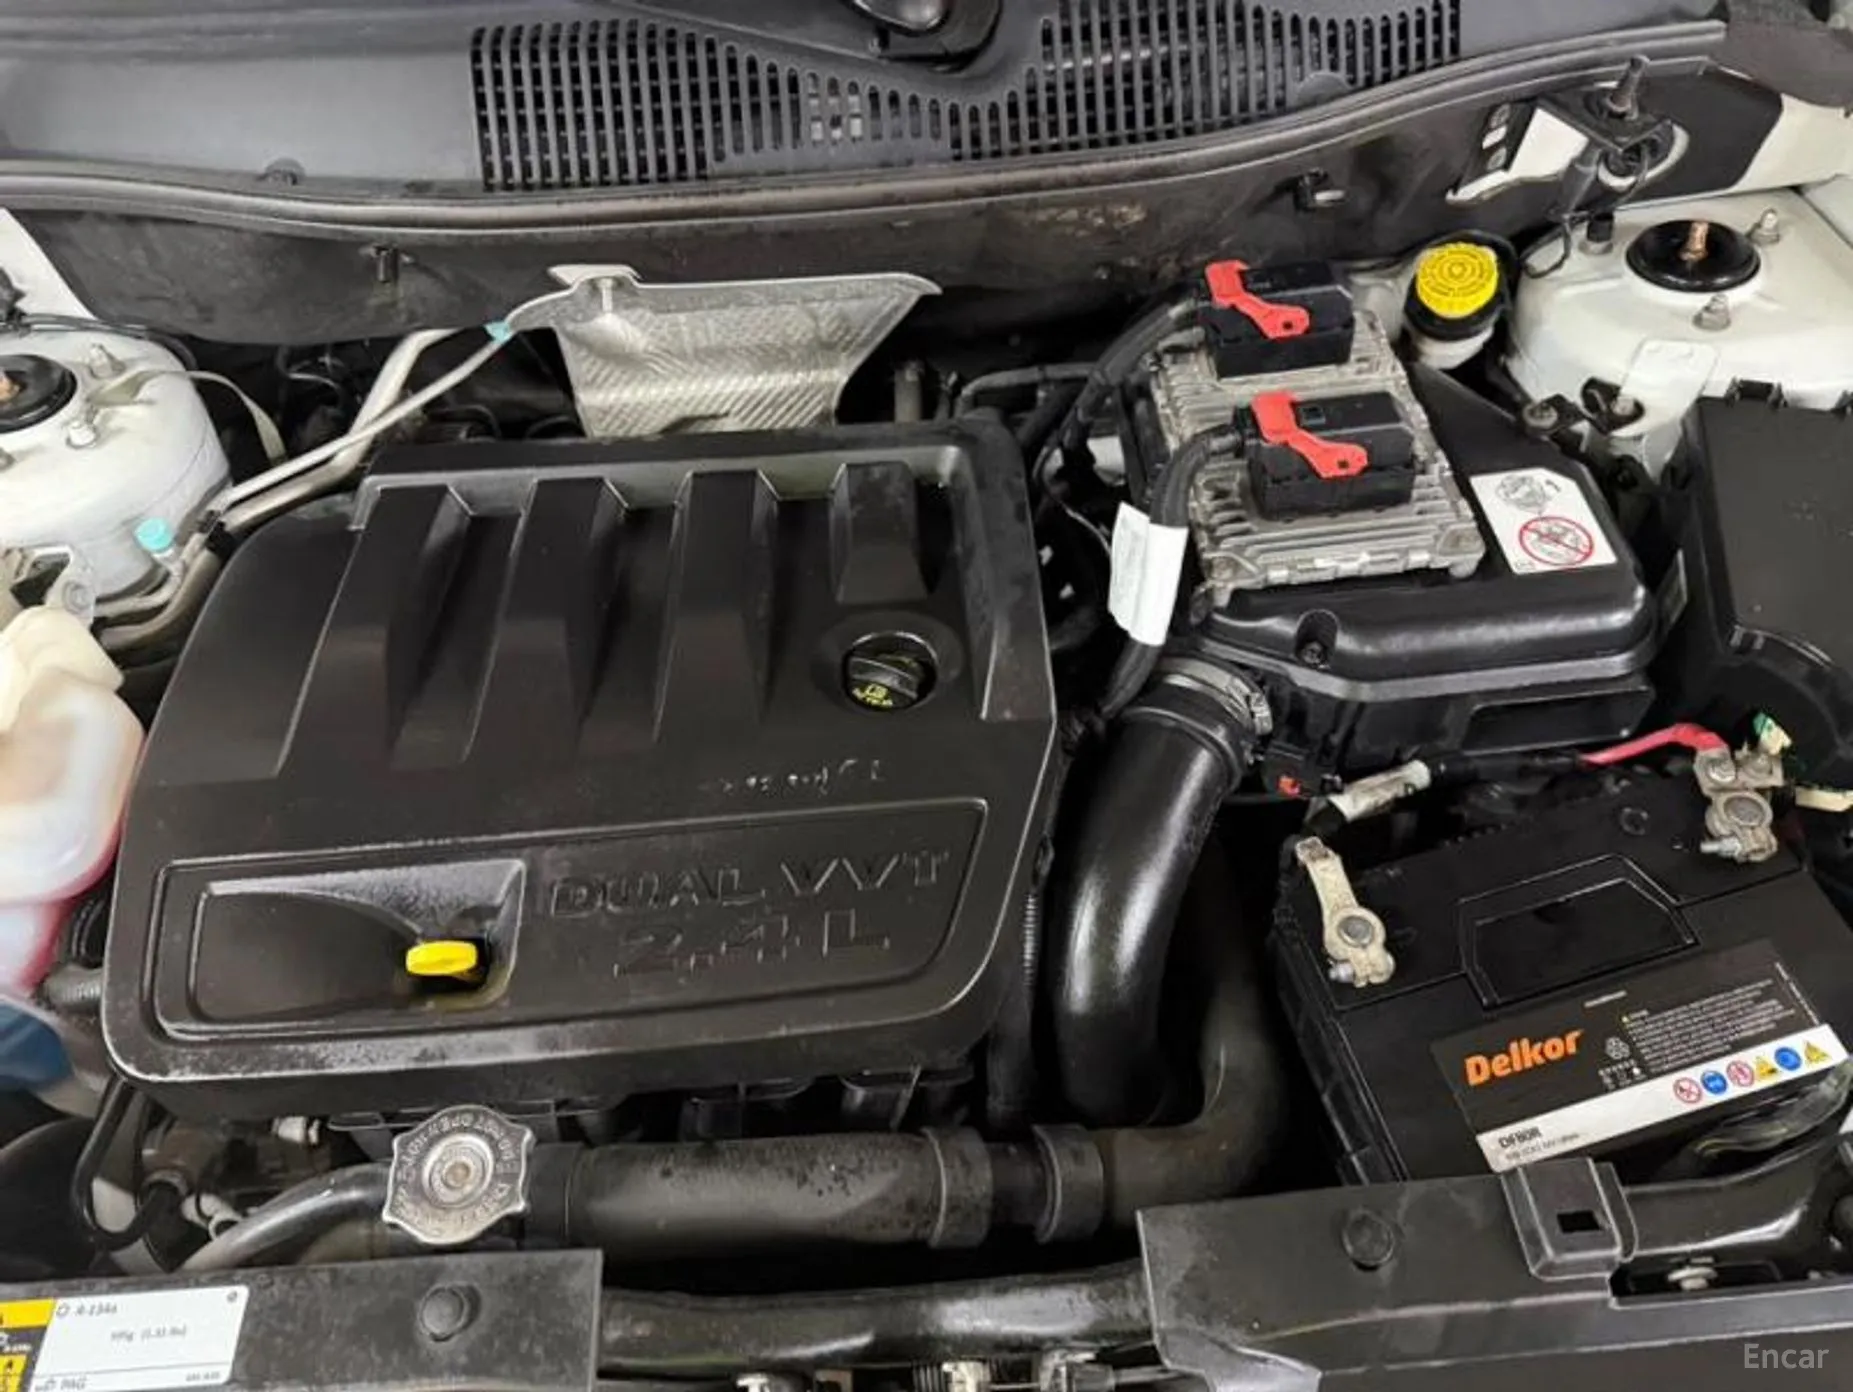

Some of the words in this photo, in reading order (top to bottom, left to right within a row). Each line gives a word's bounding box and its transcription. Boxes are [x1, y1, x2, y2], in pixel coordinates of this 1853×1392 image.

[550, 868, 768, 917] DUAL
[780, 851, 951, 897] VVT
[612, 908, 891, 978] 2.4L
[1464, 1028, 1585, 1087] Delkor
